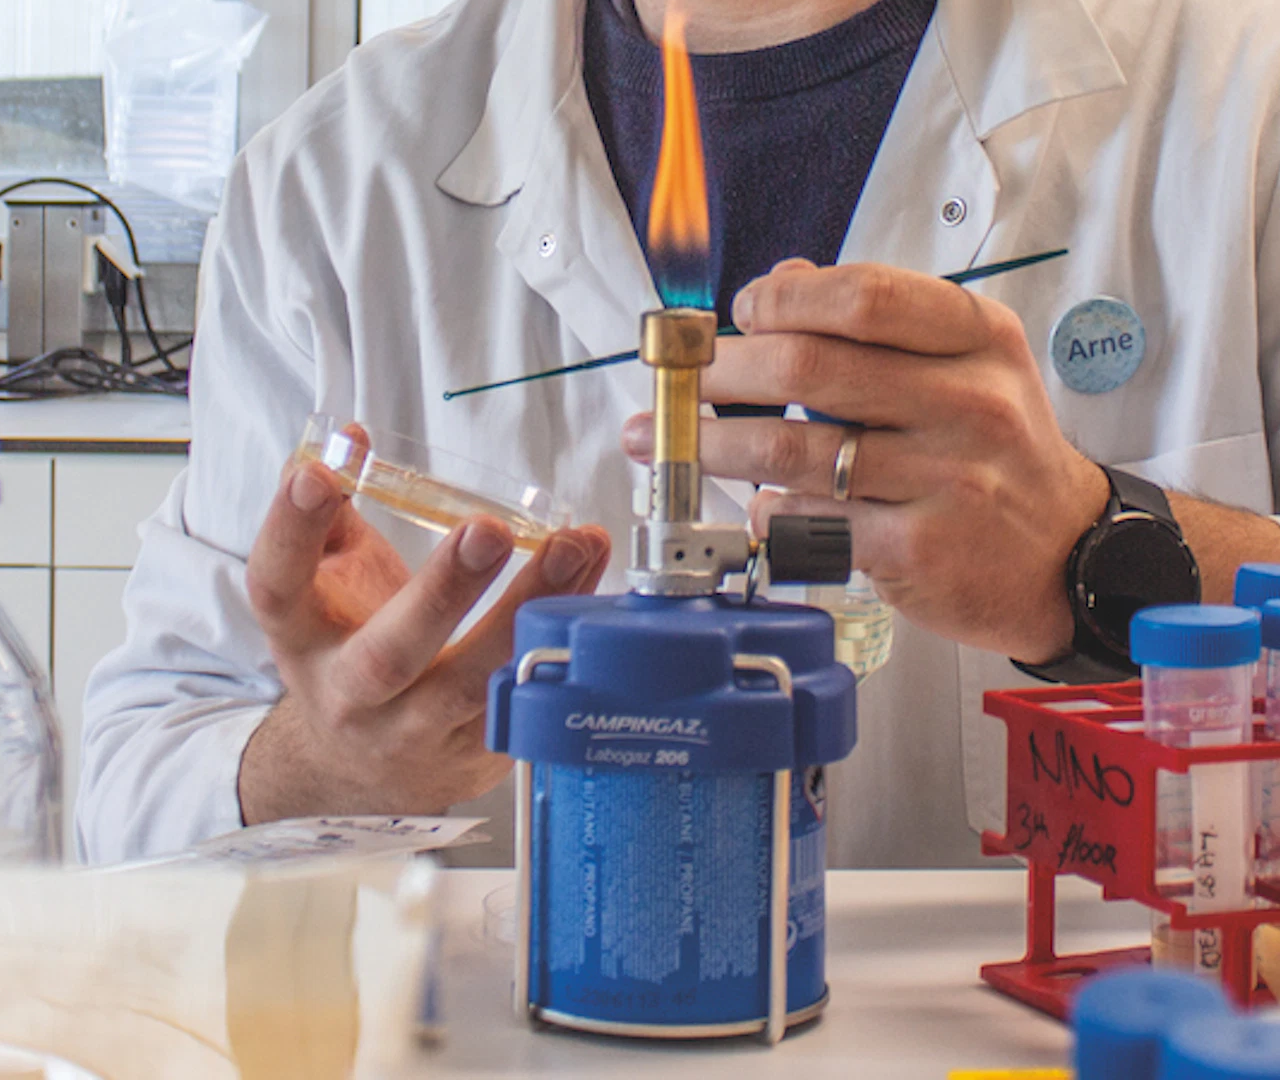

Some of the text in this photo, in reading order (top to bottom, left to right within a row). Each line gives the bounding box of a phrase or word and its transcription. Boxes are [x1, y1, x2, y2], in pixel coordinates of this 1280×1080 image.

[1067, 332, 1133, 362] Arne
[565, 713, 702, 735] CAMPINGAZ
[585, 747, 690, 766] Labogaz 206
[583, 781, 596, 846] BUTANO
[583, 862, 596, 938] PROPANO
[680, 863, 694, 935] PROPANE
